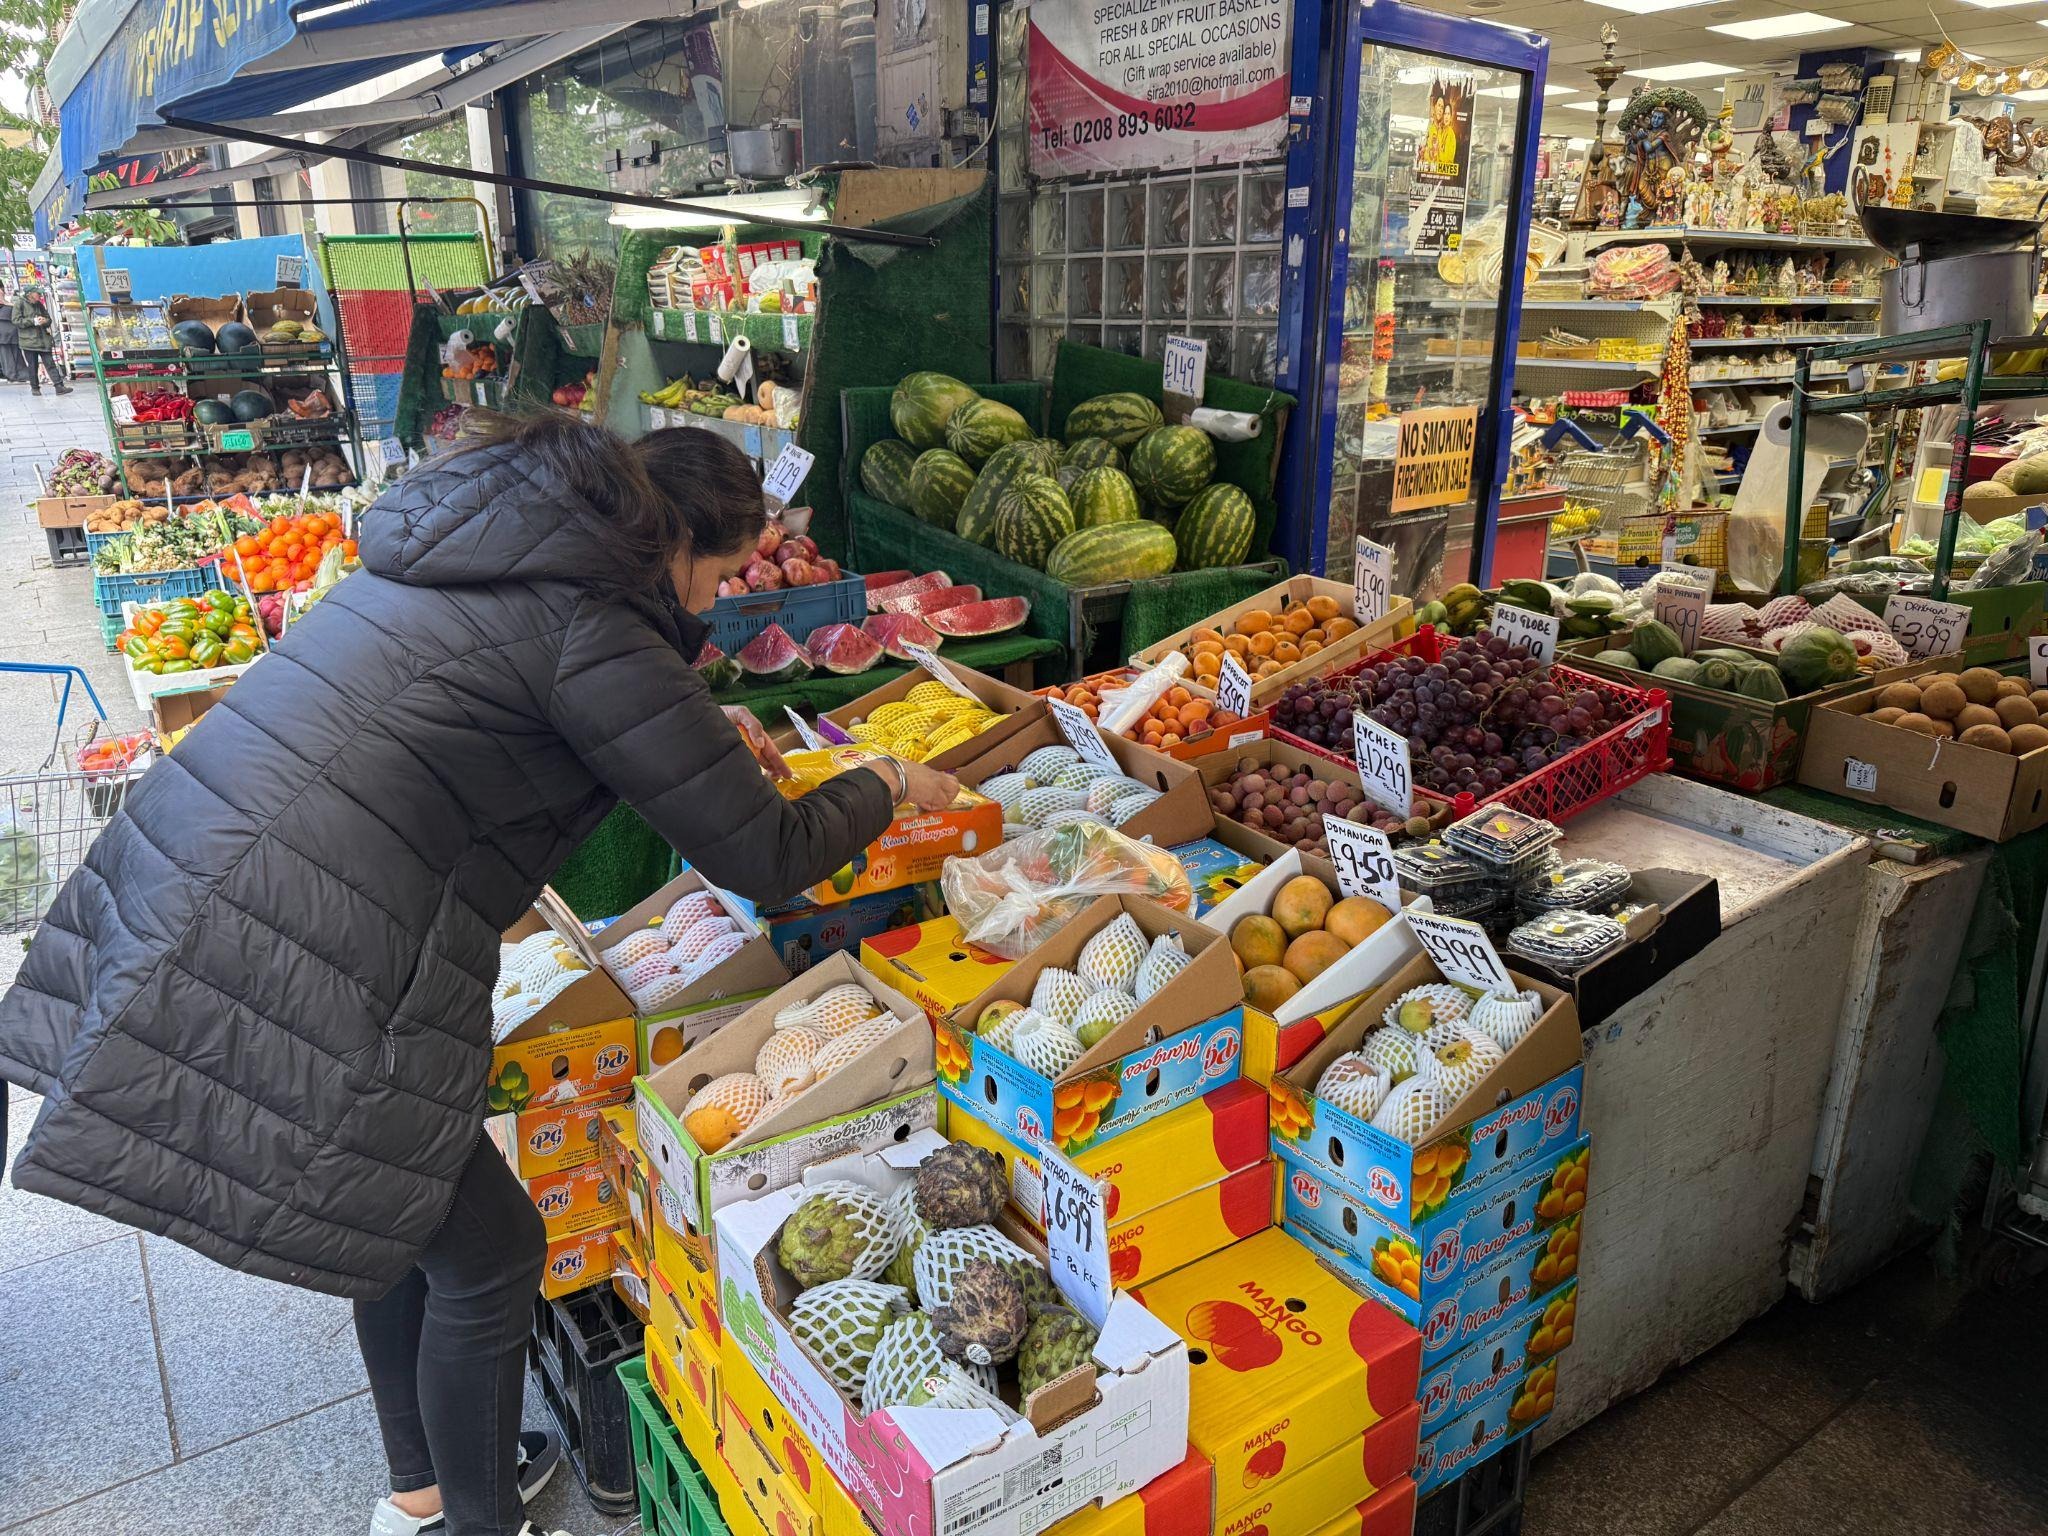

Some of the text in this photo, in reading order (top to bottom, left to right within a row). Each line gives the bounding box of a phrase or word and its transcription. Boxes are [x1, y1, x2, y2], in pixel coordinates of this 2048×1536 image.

[1099, 12, 1281, 67] FOR ALL SPECIAL OCCASIONS
[1100, 3, 1216, 45] FRESH & DRY FRUIT
[1123, 40, 1277, 88] (Gift wrap service available)
[1146, 66, 1275, 102] sira2010@hotmail.com
[1041, 102, 1196, 151] Tel: 0208 893 6032
[1438, 164, 1458, 174] HAYES
[1167, 337, 1203, 353] WATERMELON
[1165, 350, 1196, 387] £1.49
[1400, 417, 1473, 458] NO SMOKING
[1395, 457, 1469, 499] FIREWORKS ON SALE
[1357, 542, 1381, 564] LUCAT
[1657, 587, 1673, 595] RAW
[1904, 601, 1947, 616] DRAGON
[1497, 607, 1551, 636] RED GLOBE
[1888, 614, 1951, 655] £3.99
[1932, 615, 1961, 628] FRUIT
[1356, 722, 1399, 755] LYCHEE
[1357, 737, 1406, 795] £12.99
[910, 826, 958, 845] Mangoes
[1326, 821, 1384, 846] DOMANICAN
[1330, 838, 1395, 885] £9.50
[916, 990, 946, 1015] MANGO
[1122, 1032, 1202, 1079] Mangoes
[1099, 1084, 1198, 1133] Fresh Indian Alphonso
[1472, 1093, 1543, 1144] Mangoes
[816, 1111, 890, 1147] Mangoes
[1022, 1157, 1042, 1180] MAN
[1071, 1178, 1100, 1209] APPLE
[1465, 1169, 1553, 1224] Fresh Indian Alphonso
[1109, 1225, 1145, 1247] ANGO
[1424, 1235, 1460, 1274] PG
[1463, 1219, 1534, 1272] Mangoes
[1463, 1235, 1549, 1291] Fresh Indian Alphonso
[1238, 1281, 1323, 1347] MANGO
[1422, 1304, 1458, 1342] PG
[1461, 1284, 1530, 1339] Mangoes
[1510, 1308, 1545, 1335] Alphonso
[769, 1366, 808, 1427] Atibaia
[811, 1422, 818, 1438] e
[1420, 1377, 1452, 1415] PG
[1455, 1355, 1525, 1411] Mangoes
[781, 1413, 812, 1458] MANGO
[1110, 1410, 1138, 1430] PACKER
[1243, 1418, 1290, 1453] MANGO
[1437, 1423, 1508, 1479] Mangoes
[1117, 1479, 1135, 1492] 4kg
[776, 1489, 802, 1531] MANGO
[1224, 1502, 1272, 1536] MANGO
